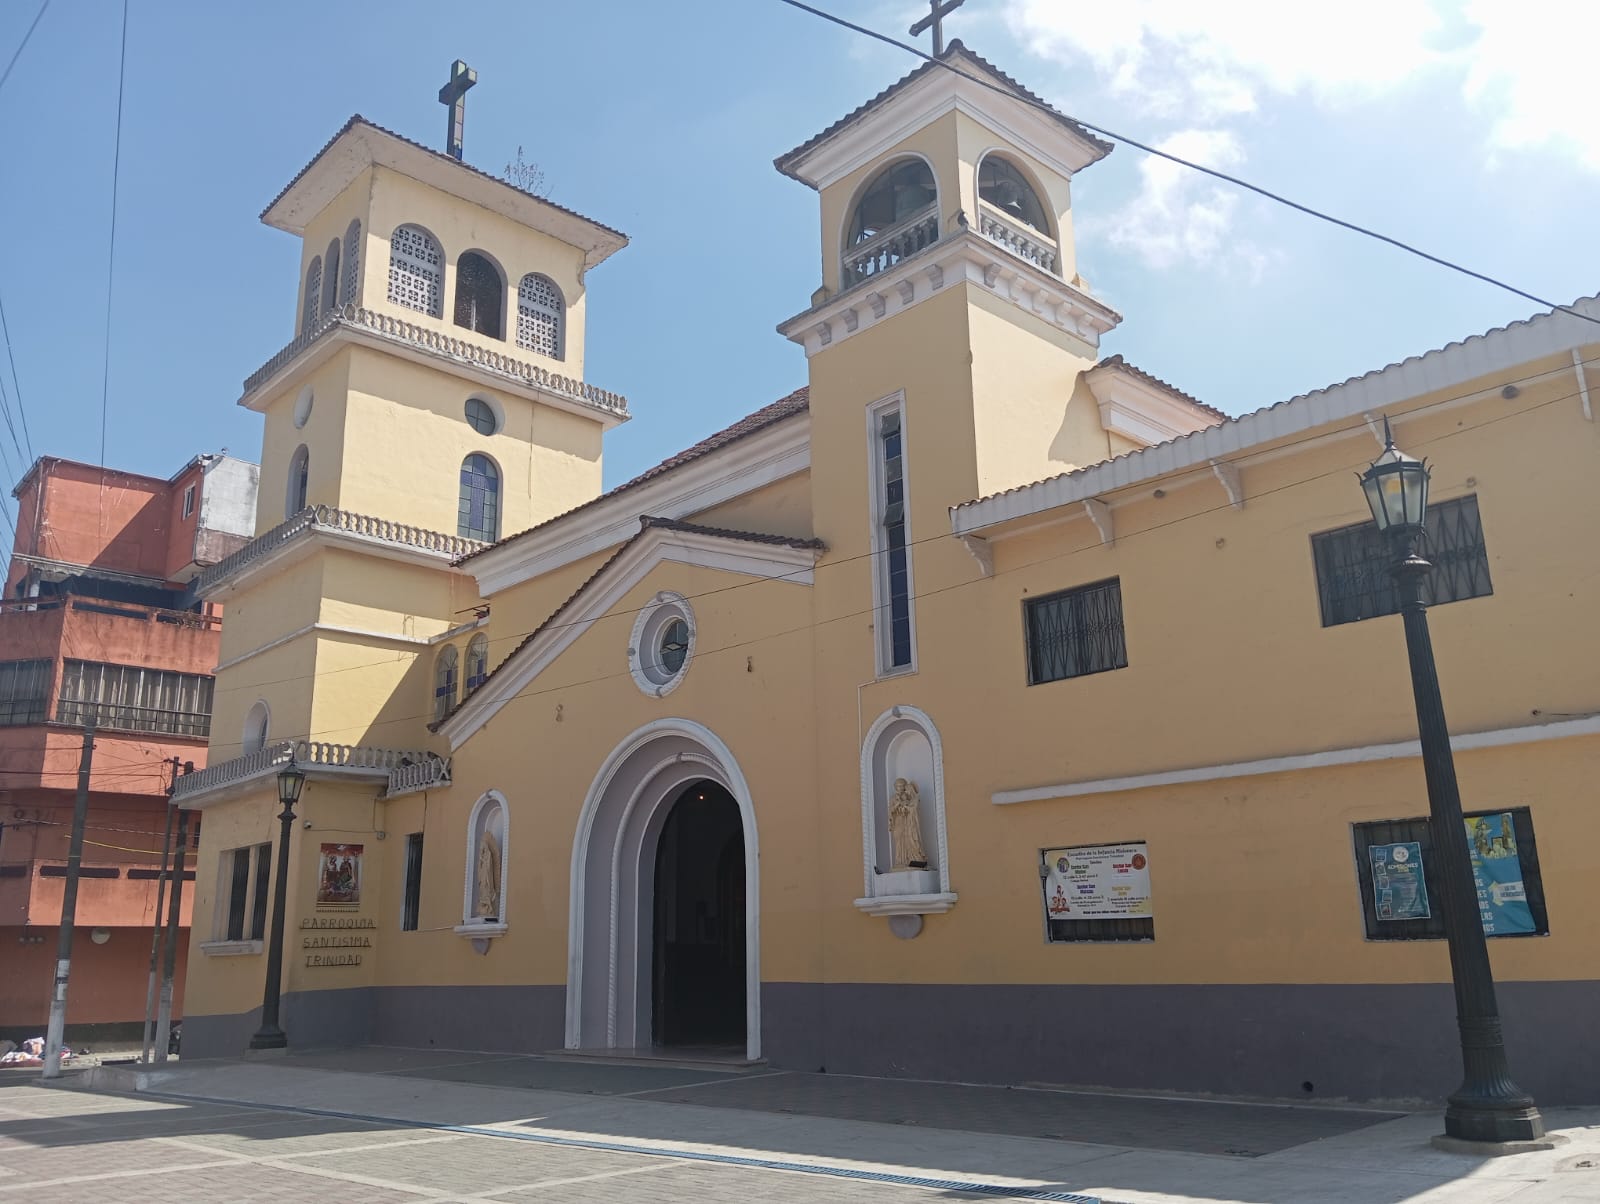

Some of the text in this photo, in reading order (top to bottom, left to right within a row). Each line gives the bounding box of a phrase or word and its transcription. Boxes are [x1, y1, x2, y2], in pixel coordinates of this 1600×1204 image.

[302, 917, 375, 929] PARROQUIA
[303, 936, 371, 948] SANTISIMA
[305, 954, 361, 967] TRINIDAD
